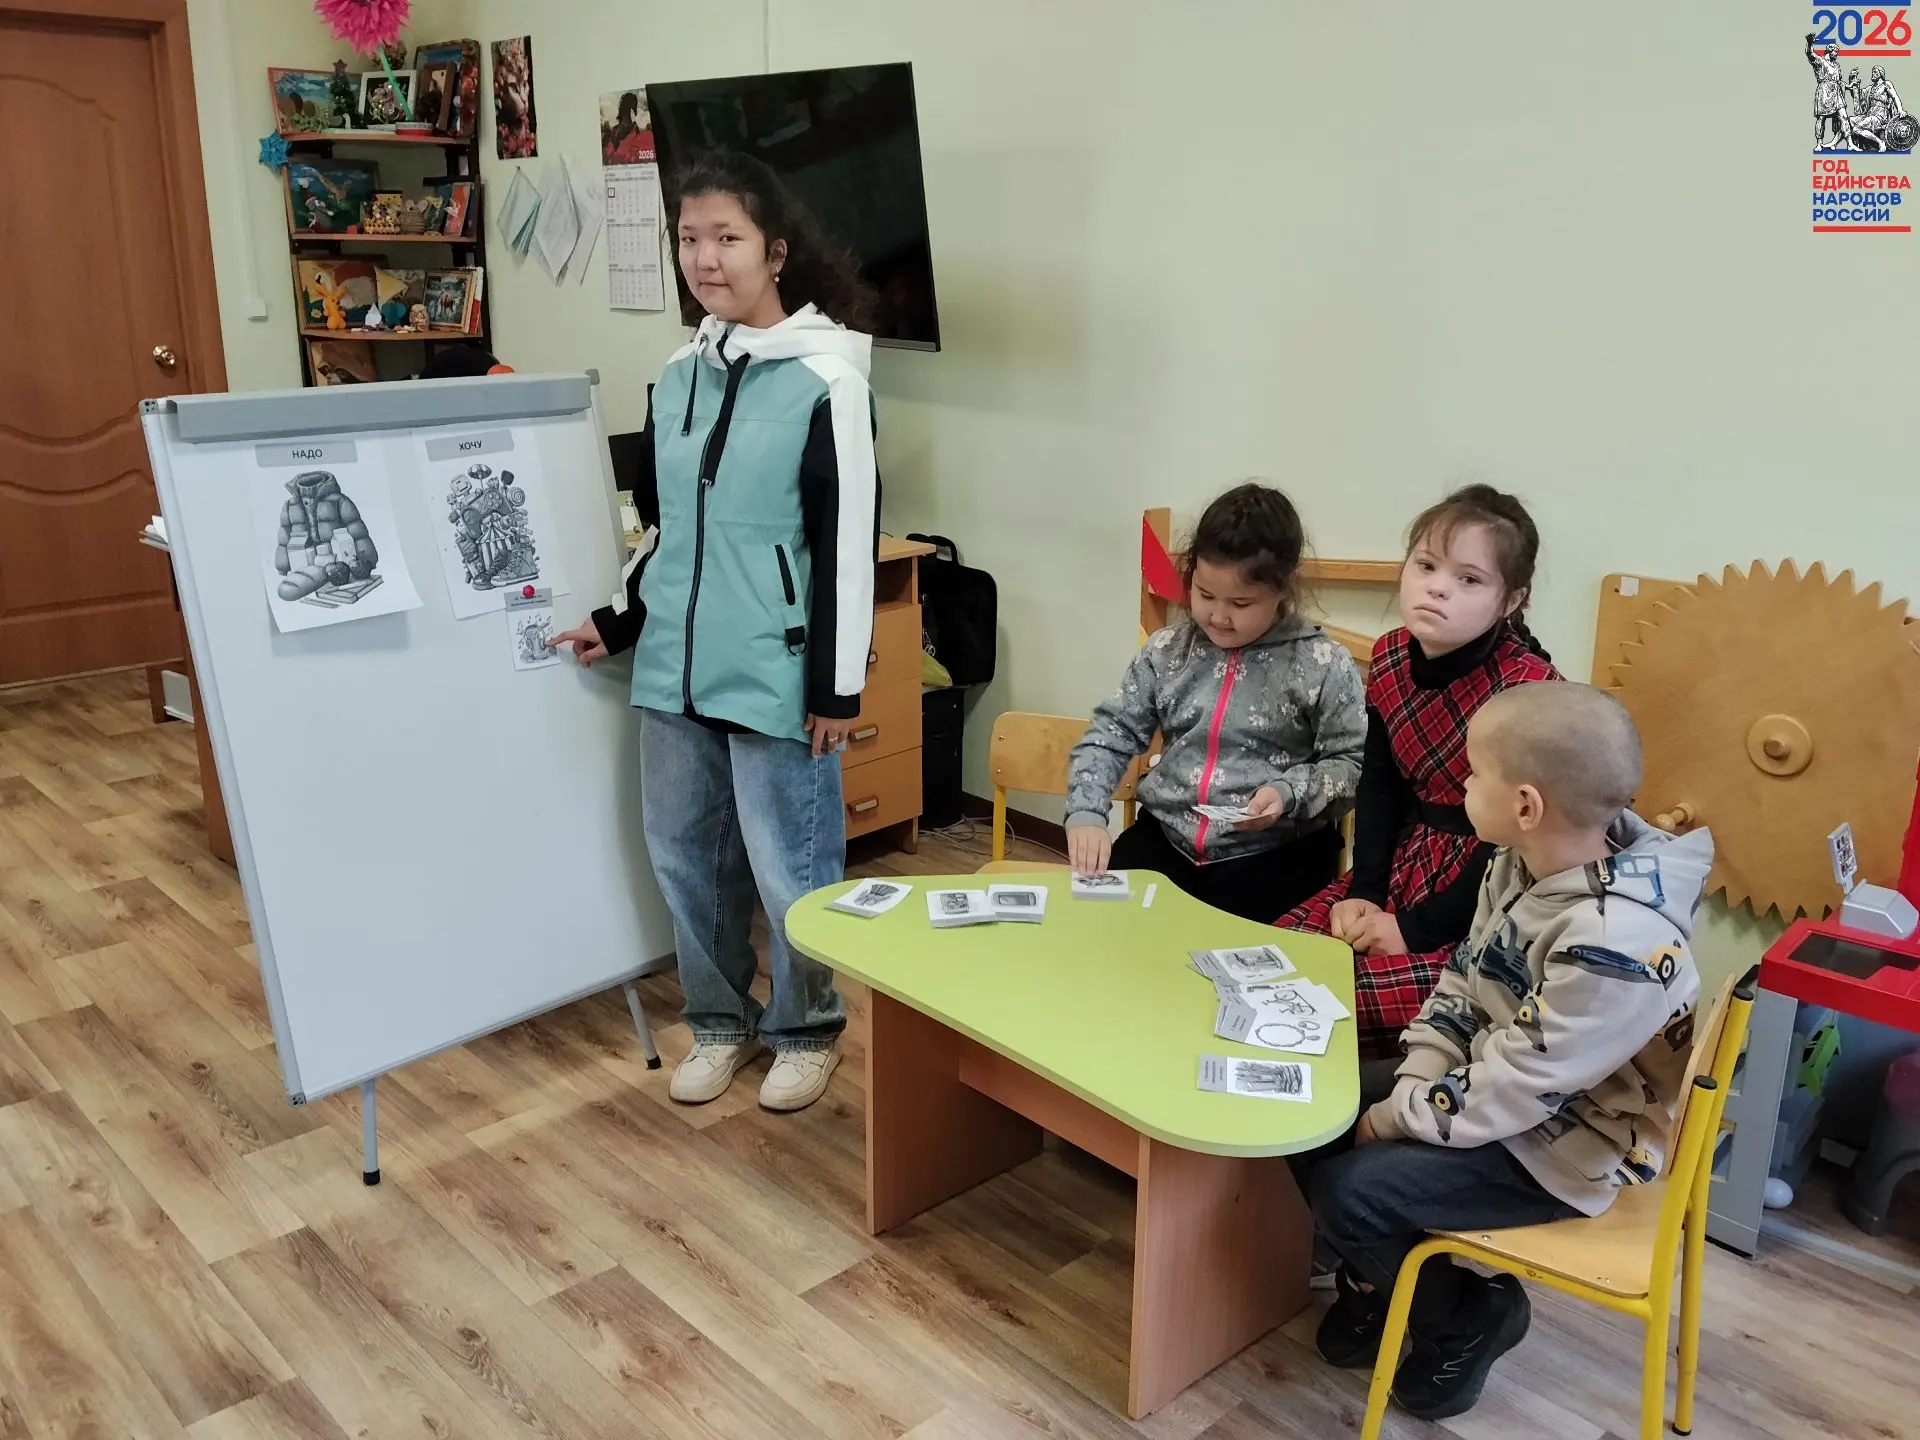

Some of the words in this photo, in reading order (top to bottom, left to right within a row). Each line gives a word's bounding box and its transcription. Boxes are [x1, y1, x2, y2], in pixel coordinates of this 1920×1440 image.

[638, 150, 654, 160] 2026
[458, 440, 482, 452] ХОЧУ
[292, 448, 323, 460] НАДО
